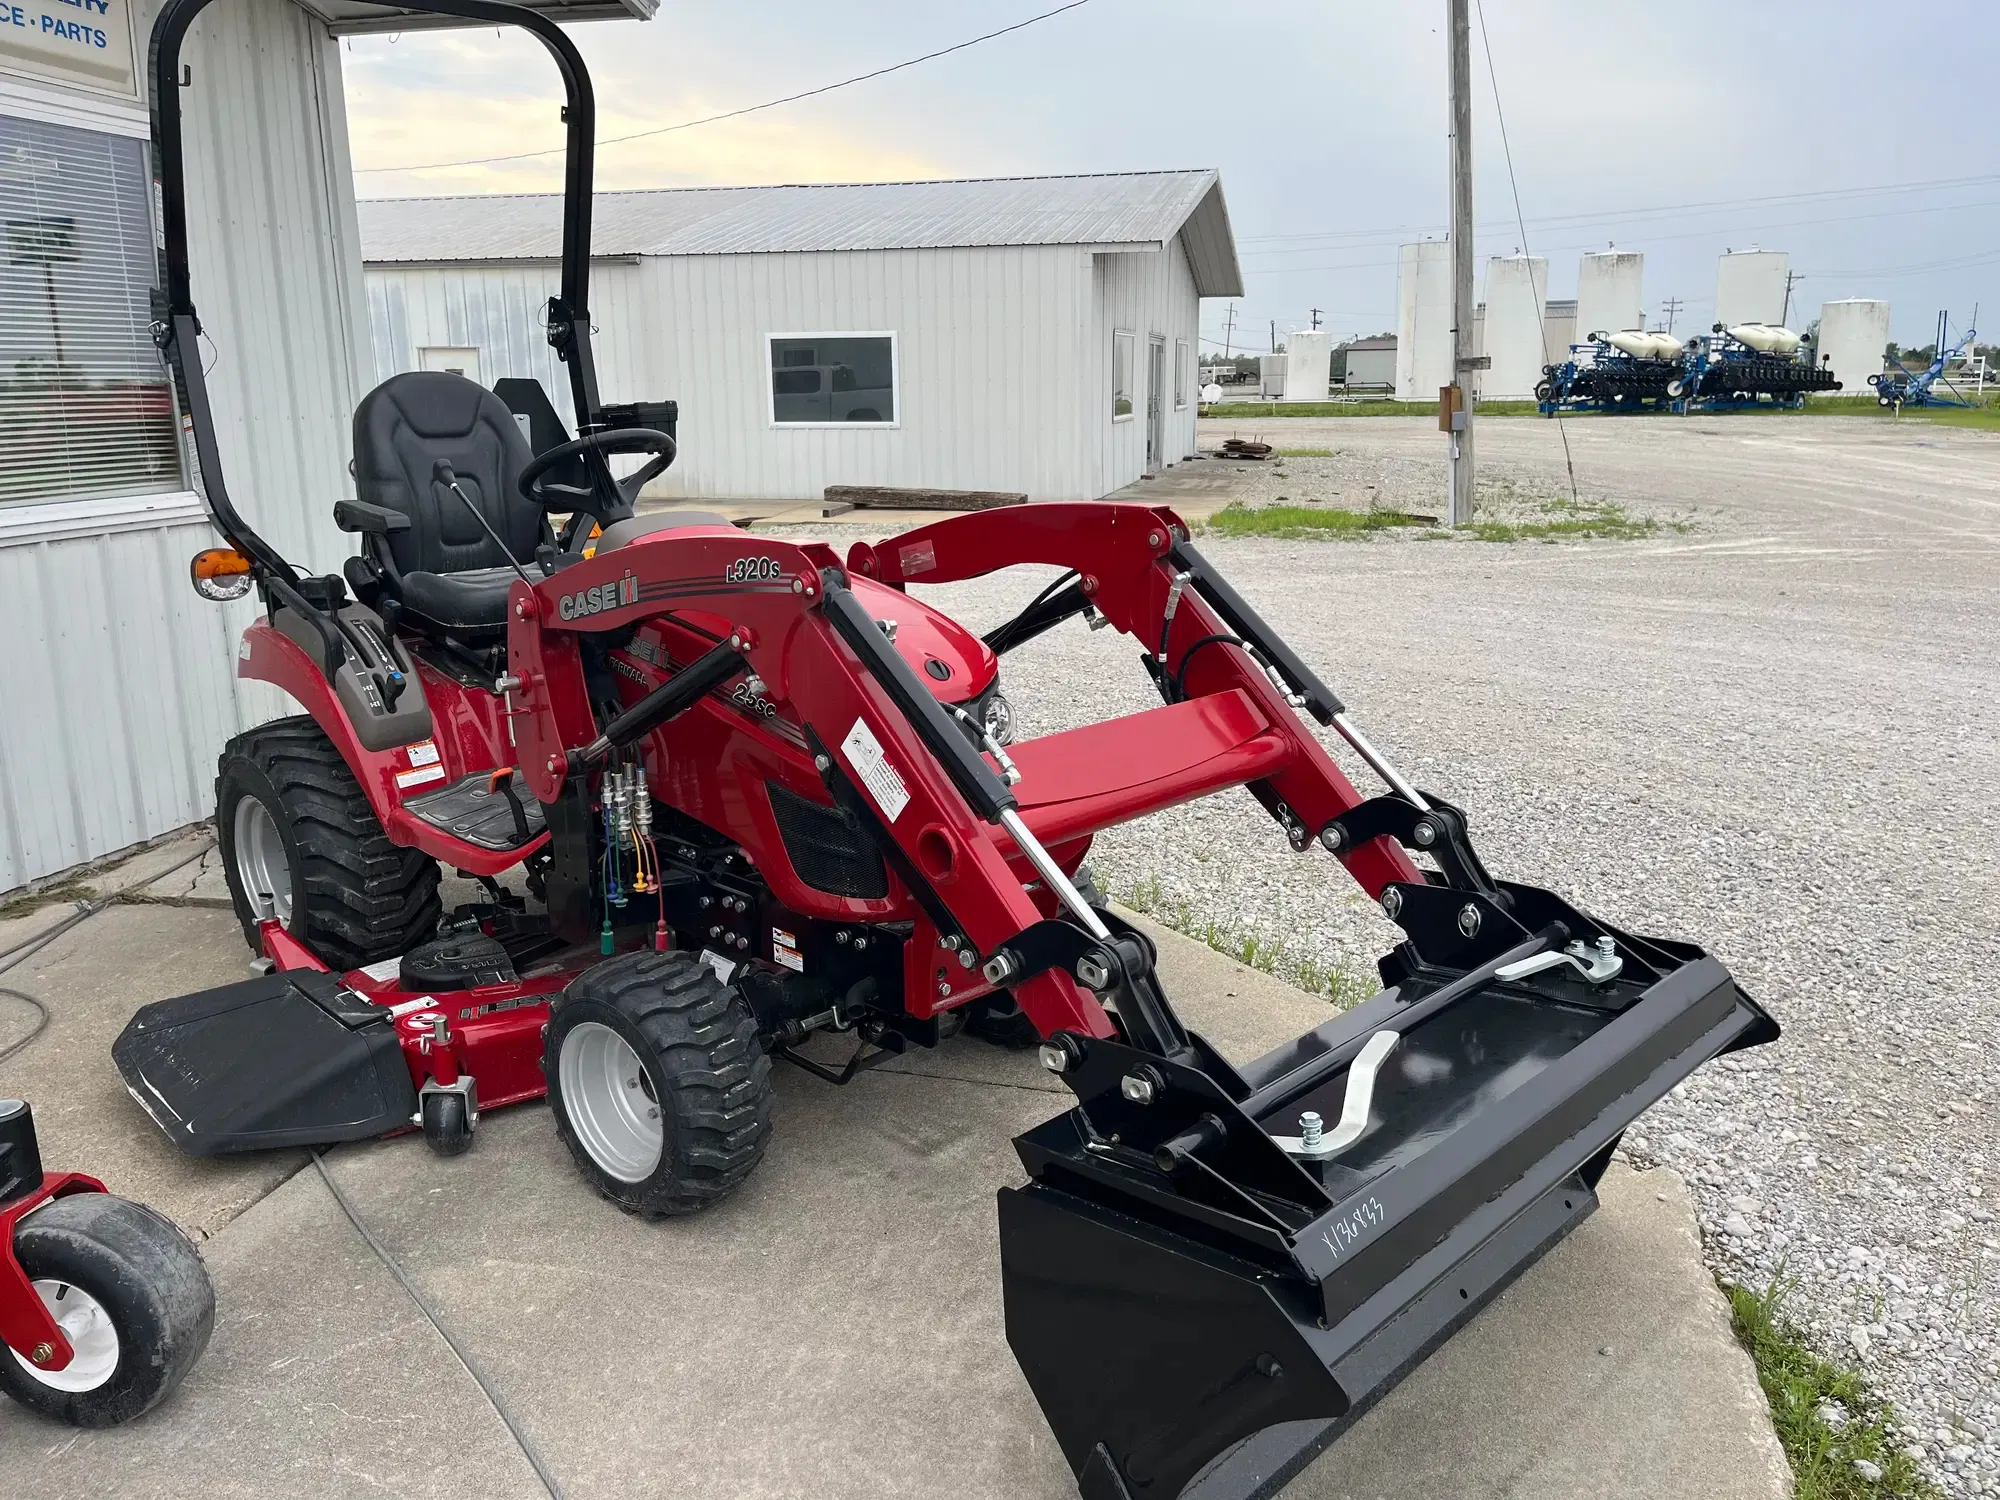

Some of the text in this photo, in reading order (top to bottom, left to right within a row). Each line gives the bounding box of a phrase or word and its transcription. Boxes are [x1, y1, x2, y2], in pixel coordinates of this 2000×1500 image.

[41, 14, 107, 48] PARTS
[559, 568, 639, 621] CASE IH
[608, 655, 648, 687] FARMALL
